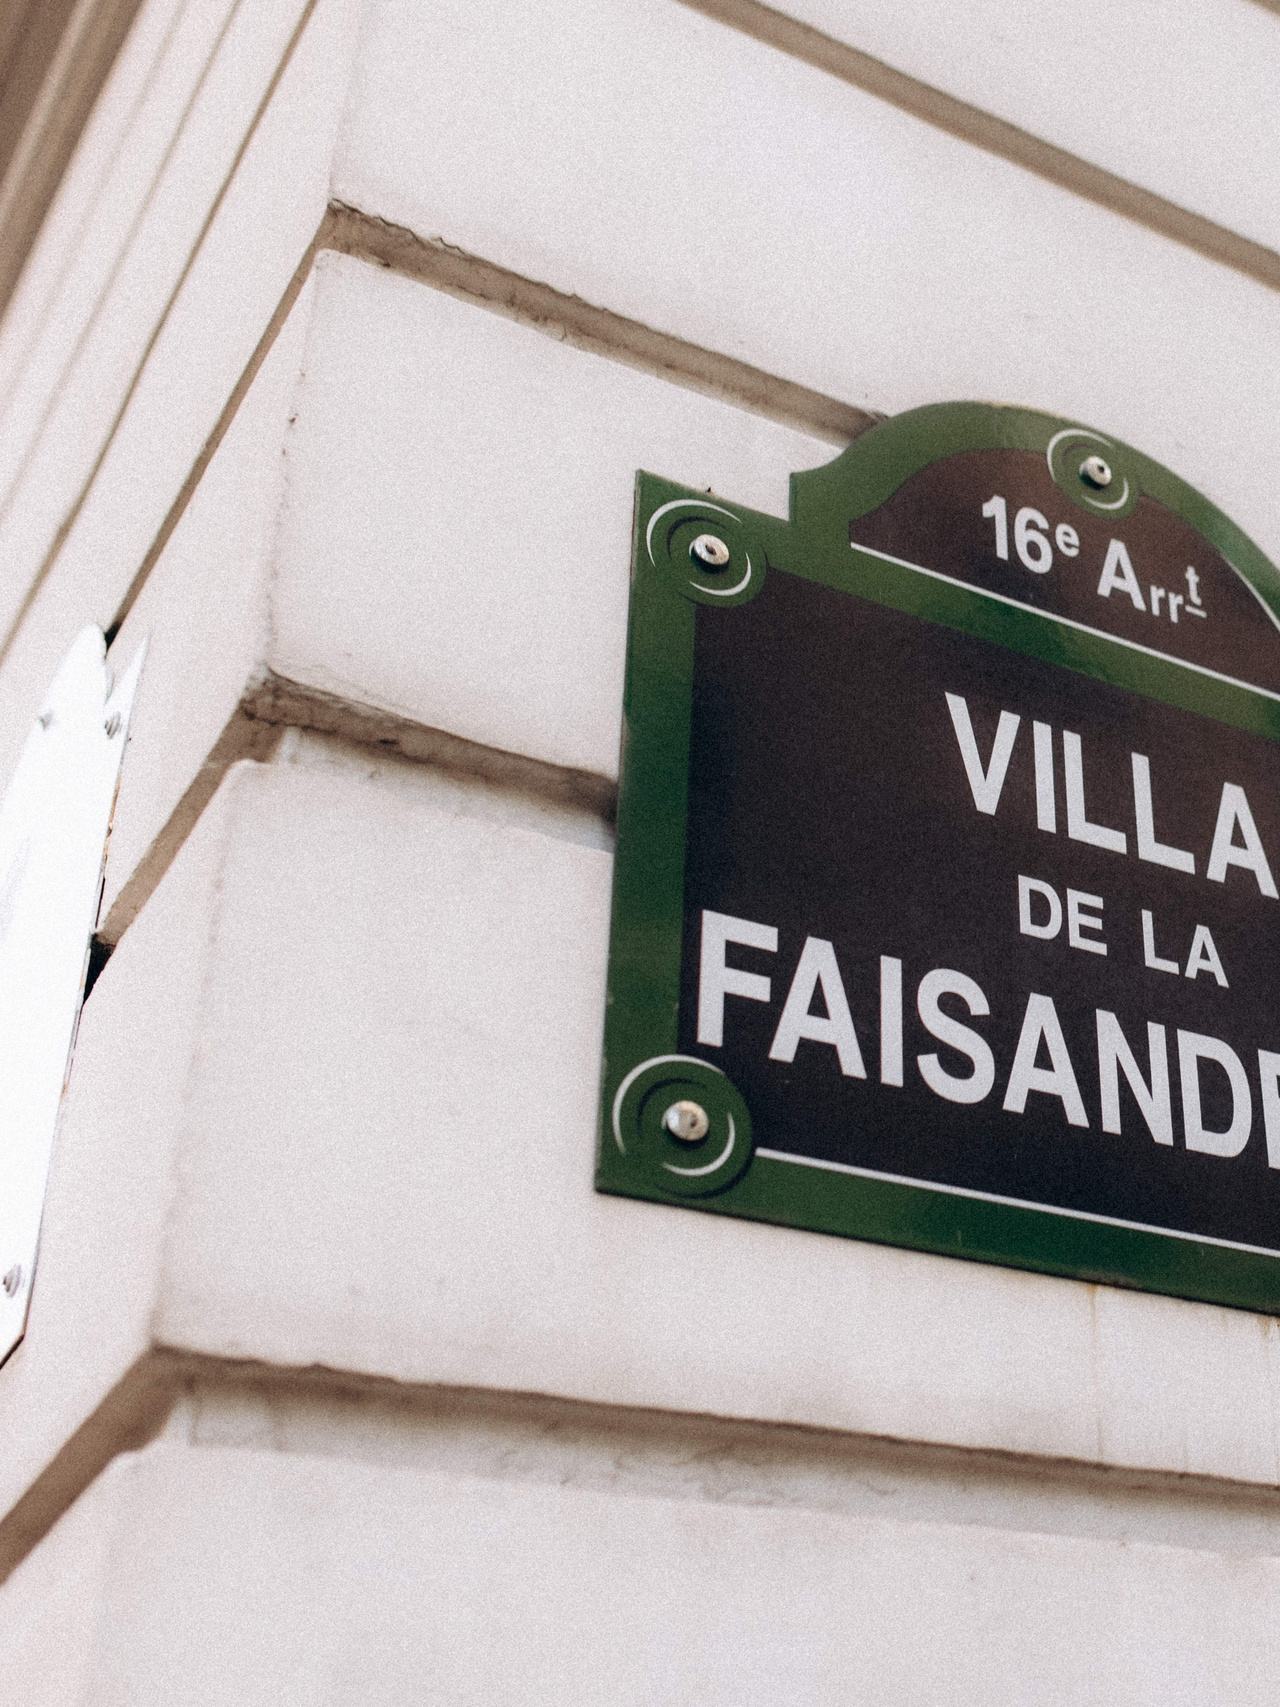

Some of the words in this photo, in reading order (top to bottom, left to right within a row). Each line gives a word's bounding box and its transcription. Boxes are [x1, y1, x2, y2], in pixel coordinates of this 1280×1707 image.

[944, 691, 1280, 901] VILLA
[1017, 874, 1108, 956] DE
[1141, 909, 1231, 989] LA
